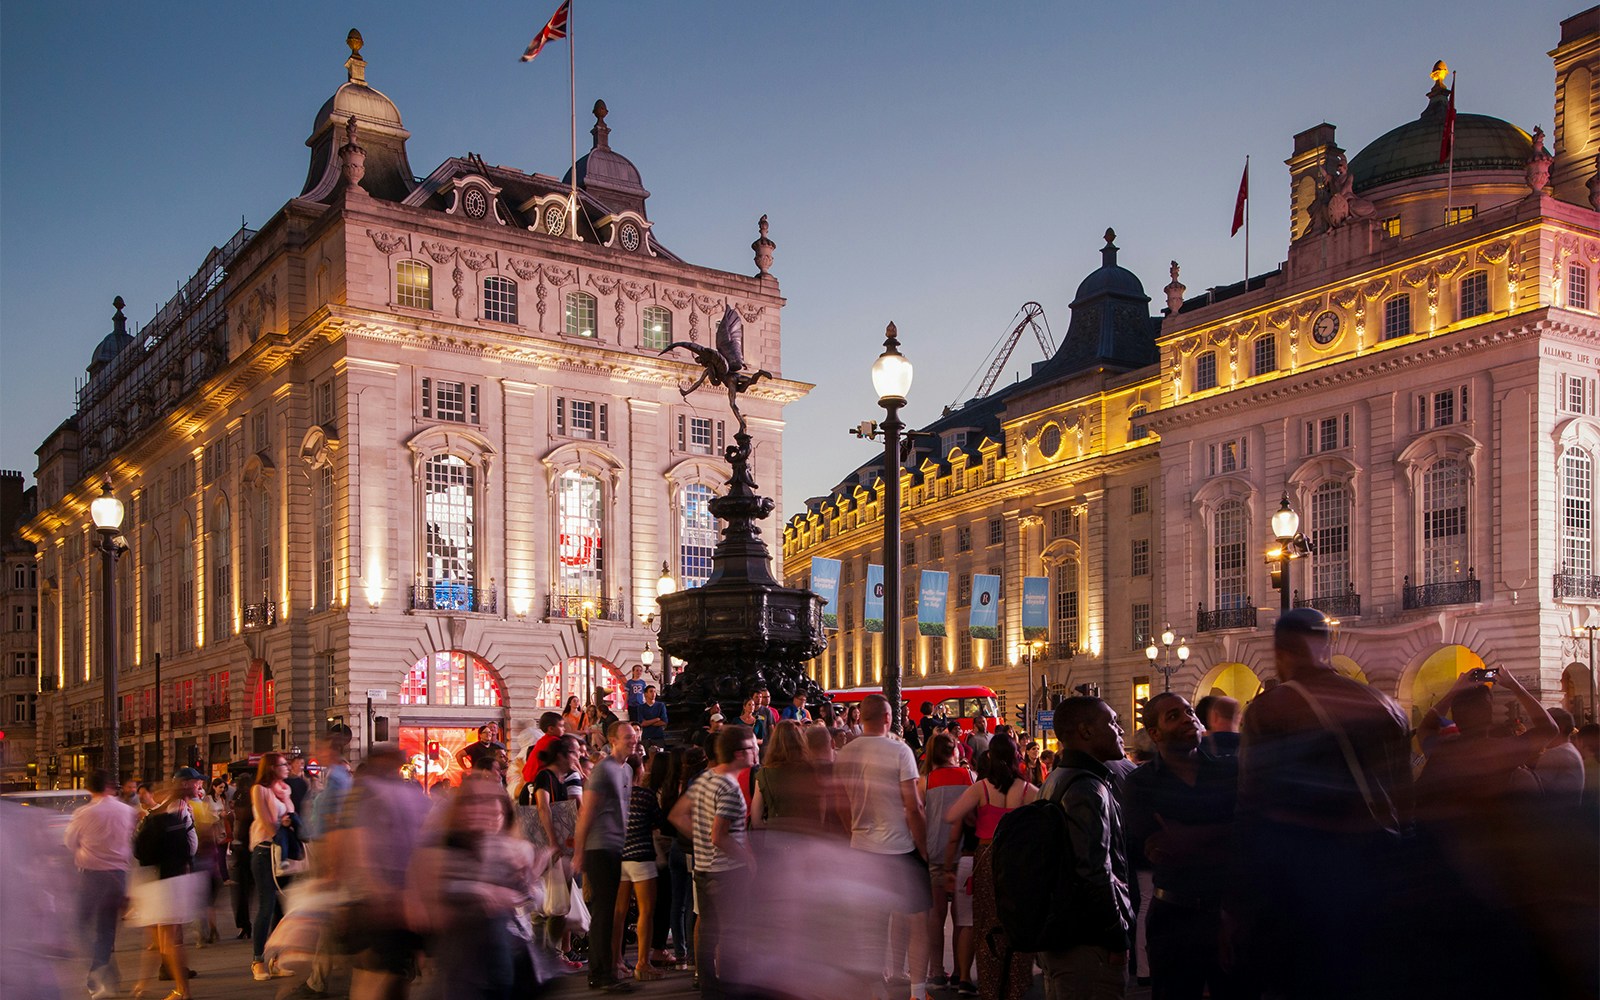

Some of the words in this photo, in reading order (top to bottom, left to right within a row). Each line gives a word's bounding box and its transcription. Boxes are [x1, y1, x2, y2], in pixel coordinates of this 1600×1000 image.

[1544, 346, 1572, 360] ALLIANCE
[1577, 354, 1590, 364] LIFE
[633, 686, 642, 694] 82
